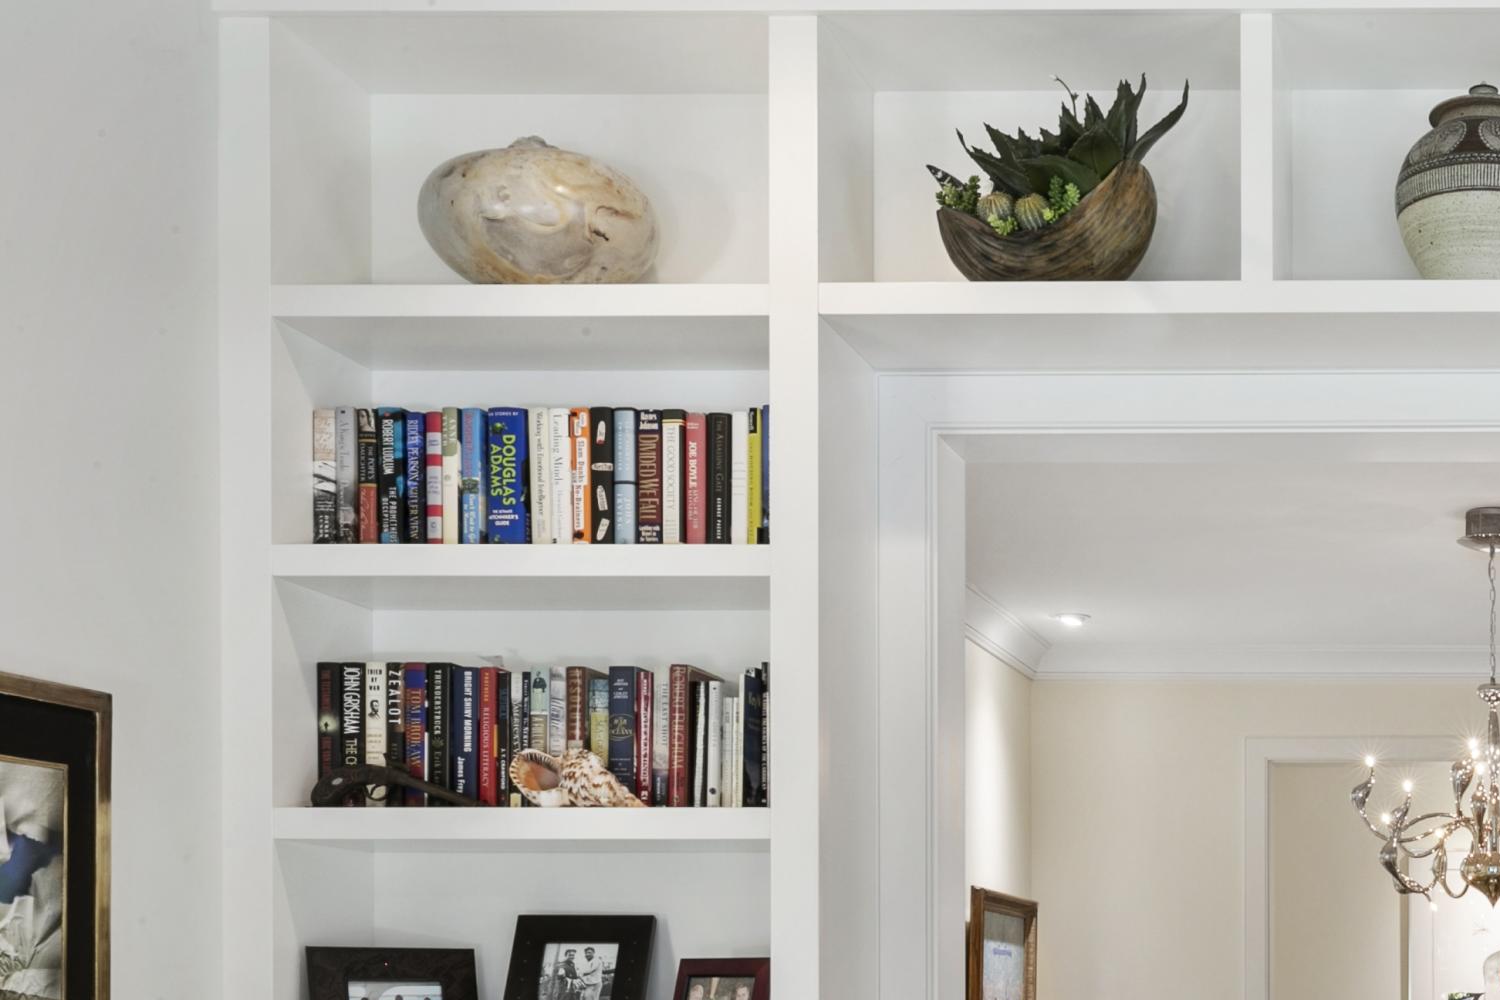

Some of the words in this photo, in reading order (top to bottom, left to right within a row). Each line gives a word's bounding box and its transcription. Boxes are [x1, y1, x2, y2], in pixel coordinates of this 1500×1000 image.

[382, 419, 394, 445] ROBERT
[552, 414, 563, 453] Leading
[382, 447, 395, 475] LUDLUM
[406, 447, 419, 481] PEARSON
[639, 434, 660, 477] DIVIDED
[689, 441, 697, 458] JOE
[491, 443, 503, 496] ADAMS
[502, 434, 516, 505] DOUGLAS
[553, 456, 563, 485] Minds
[689, 459, 697, 489] BOYLE
[389, 487, 397, 498] THE
[639, 478, 660, 495] WE
[639, 497, 660, 519] FALL
[344, 667, 361, 691] JOHN
[463, 671, 473, 696] BRIGHT
[671, 667, 686, 707] ROBERT
[389, 670, 402, 725] ZEALOT
[410, 689, 421, 713] TOM
[434, 670, 442, 735] THUNDERSTRUCK
[463, 697, 473, 718] SHINY
[344, 692, 361, 734] GRISHAM
[482, 706, 490, 748] RELIGIOUS
[346, 738, 358, 754] THE
[410, 717, 421, 768] BROKAW
[463, 719, 473, 752] MORNING
[671, 713, 686, 768] FULGHUM
[456, 756, 465, 778] James
[482, 750, 490, 787] LITERACY
[456, 779, 466, 793] Frey
